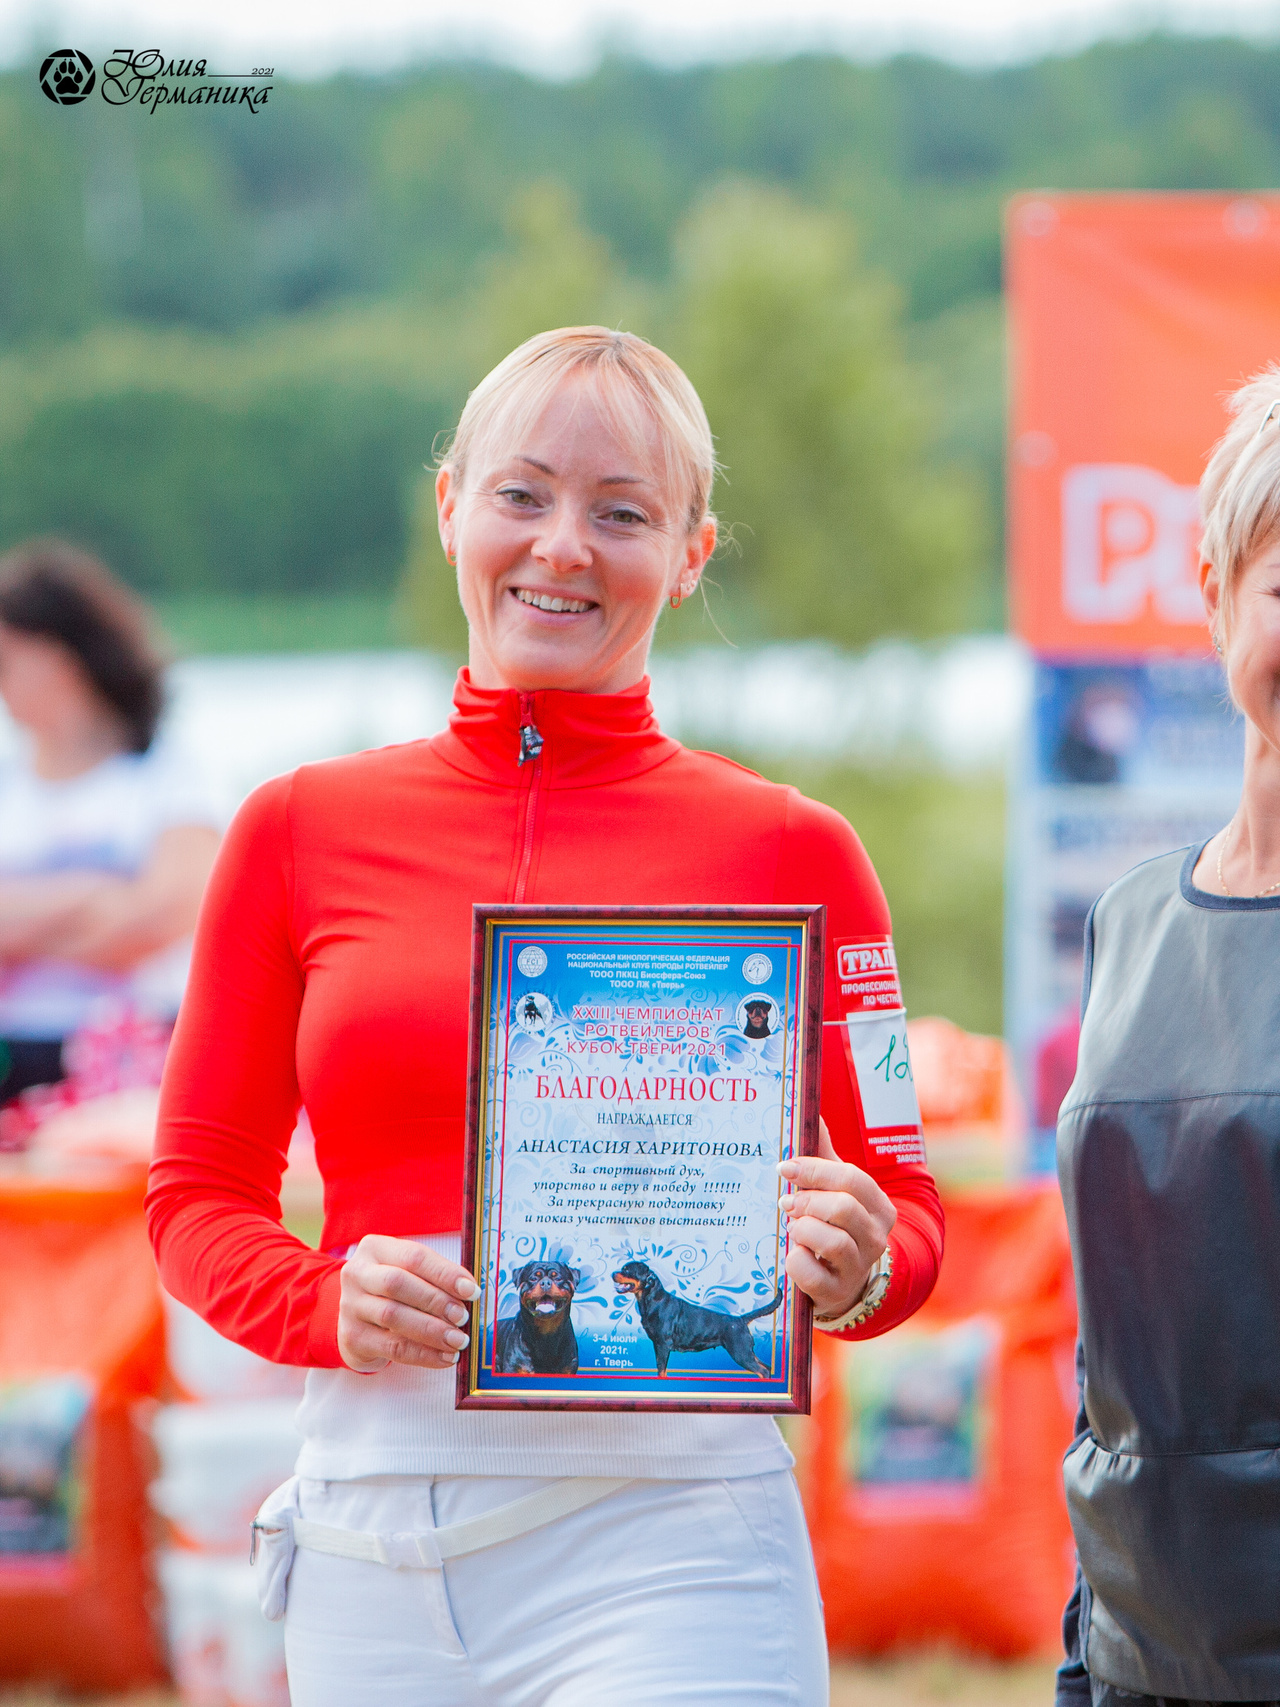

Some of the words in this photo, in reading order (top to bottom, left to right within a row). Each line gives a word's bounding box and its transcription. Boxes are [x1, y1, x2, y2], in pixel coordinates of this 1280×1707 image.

[566, 953, 616, 961] РОССИЙСКАЯ
[617, 954, 685, 962] КИНОЛОГИЧЕСКАЯ
[686, 955, 730, 963] ФЕДЕРАЦИЯ
[843, 949, 897, 972] ТРАП
[568, 961, 630, 969] НАЦИОНАЛЬНЫЙ
[651, 962, 682, 970] ПОРОДЫ
[589, 970, 614, 978] ТООО
[615, 971, 639, 980] ПККЦ
[640, 971, 706, 981] Биосфера-Союз
[609, 980, 634, 988] ТООО
[651, 981, 685, 989] «Тверь»
[863, 995, 876, 1005] ПО
[573, 1007, 610, 1019] XXIII
[616, 1007, 724, 1021] ЧЕМПИОНАТ
[585, 1023, 710, 1038] РОТВЕЙЛЕРОВ
[567, 1041, 625, 1054] КУБОК
[626, 1042, 681, 1055] ТВЕРИ
[687, 1043, 726, 1056] 2021
[534, 1075, 757, 1105] БЛАГОДАРНОСТЬ
[597, 1112, 692, 1127] НАГРАЖДАЕТСЯ
[517, 1139, 630, 1154] АНАСТАСИЯ
[633, 1141, 763, 1156] ХАРИТОНОВА
[570, 1163, 586, 1174] За
[593, 1164, 676, 1178] спортивный
[679, 1164, 705, 1178] дух,
[532, 1182, 596, 1193] упорство
[599, 1183, 607, 1191] и
[611, 1183, 639, 1194] веру
[642, 1184, 649, 1192] в
[652, 1181, 696, 1194] победу
[547, 1195, 563, 1207] За
[567, 1199, 645, 1211] прекрасную
[648, 1198, 726, 1213] подготовку
[525, 1215, 533, 1223] и
[536, 1215, 573, 1224] показ
[576, 1216, 655, 1227] участников
[659, 1215, 747, 1226] выставки!!!!
[592, 1333, 608, 1343] 3-4
[610, 1335, 637, 1343] июля
[600, 1345, 629, 1355] 2021г.
[603, 1357, 634, 1369] Тверь
